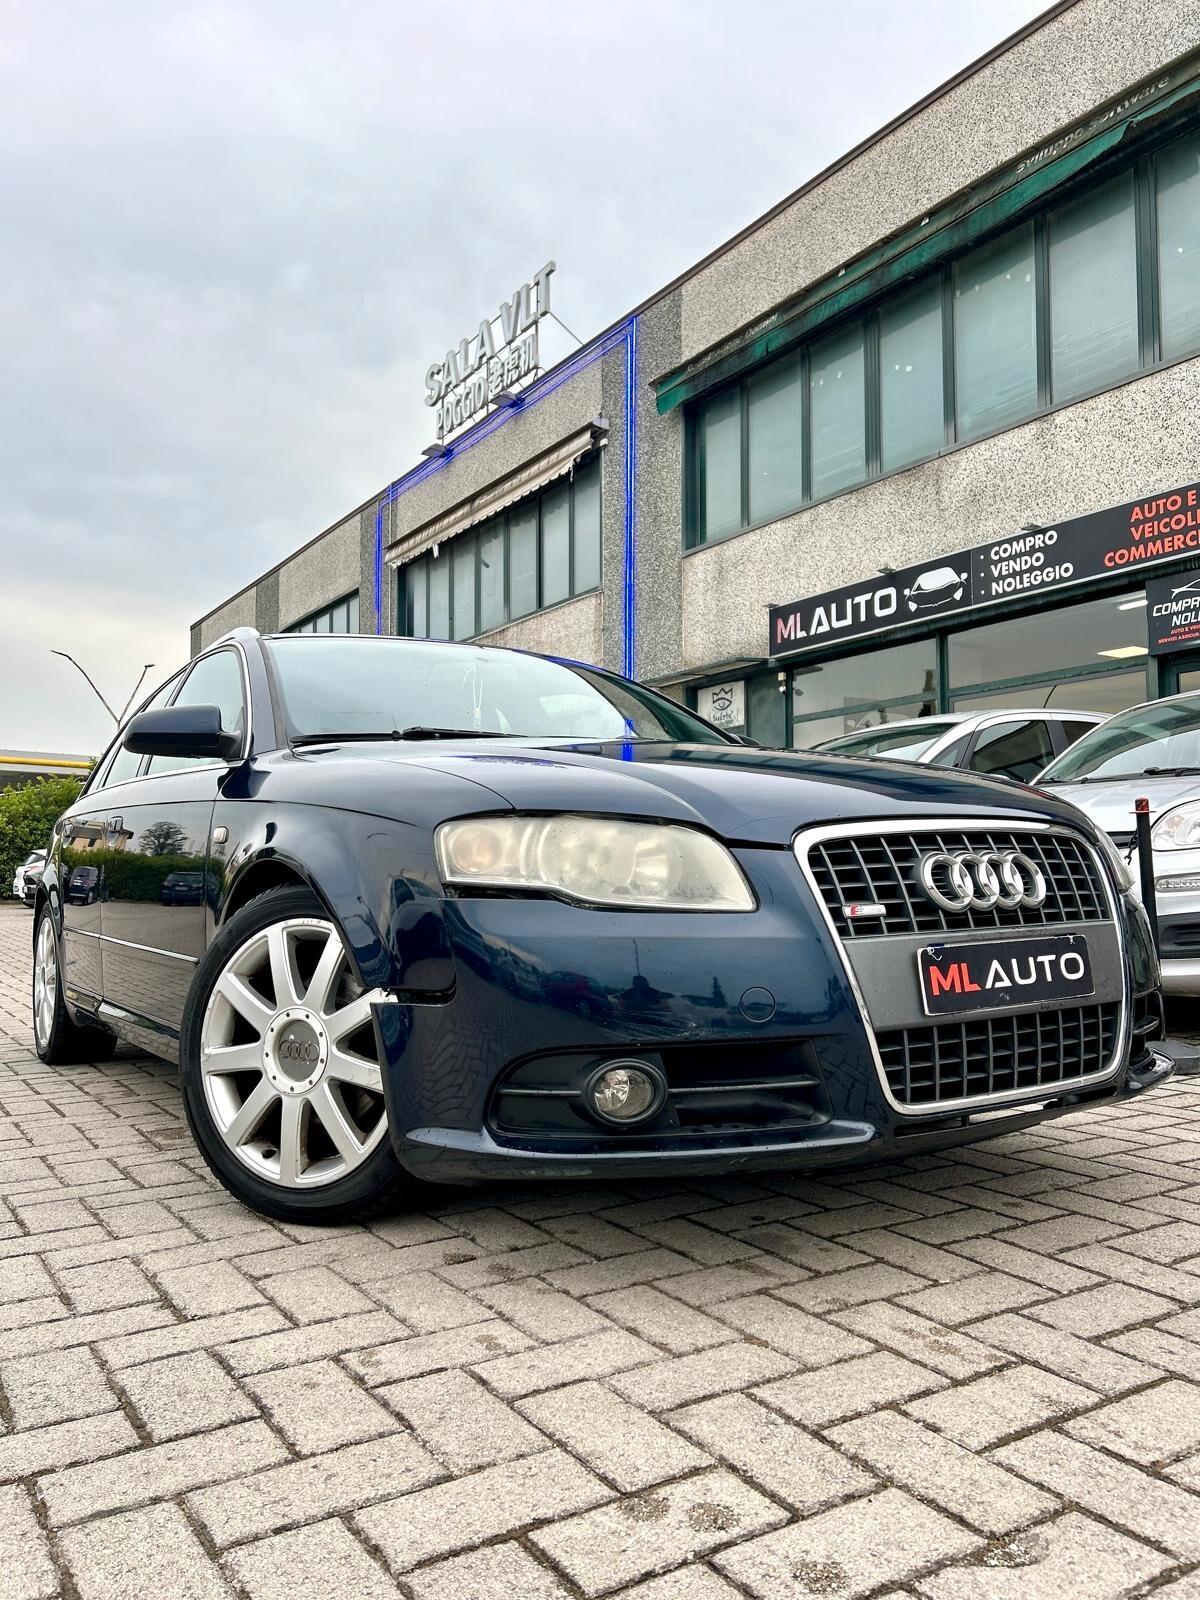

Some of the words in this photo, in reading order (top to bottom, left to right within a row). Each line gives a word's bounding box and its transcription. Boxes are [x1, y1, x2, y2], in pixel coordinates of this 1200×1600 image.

[425, 319, 495, 406] SALA
[500, 260, 556, 345] VLT
[436, 377, 488, 440] POGGIO
[1130, 495, 1182, 523] AUTO
[1187, 489, 1197, 507] E
[990, 530, 1058, 560] COMPRO
[990, 552, 1045, 578] VENDO
[991, 562, 1074, 596] NOLEGGIO
[1170, 627, 1185, 635] AUTO
[1171, 610, 1200, 627] NOL
